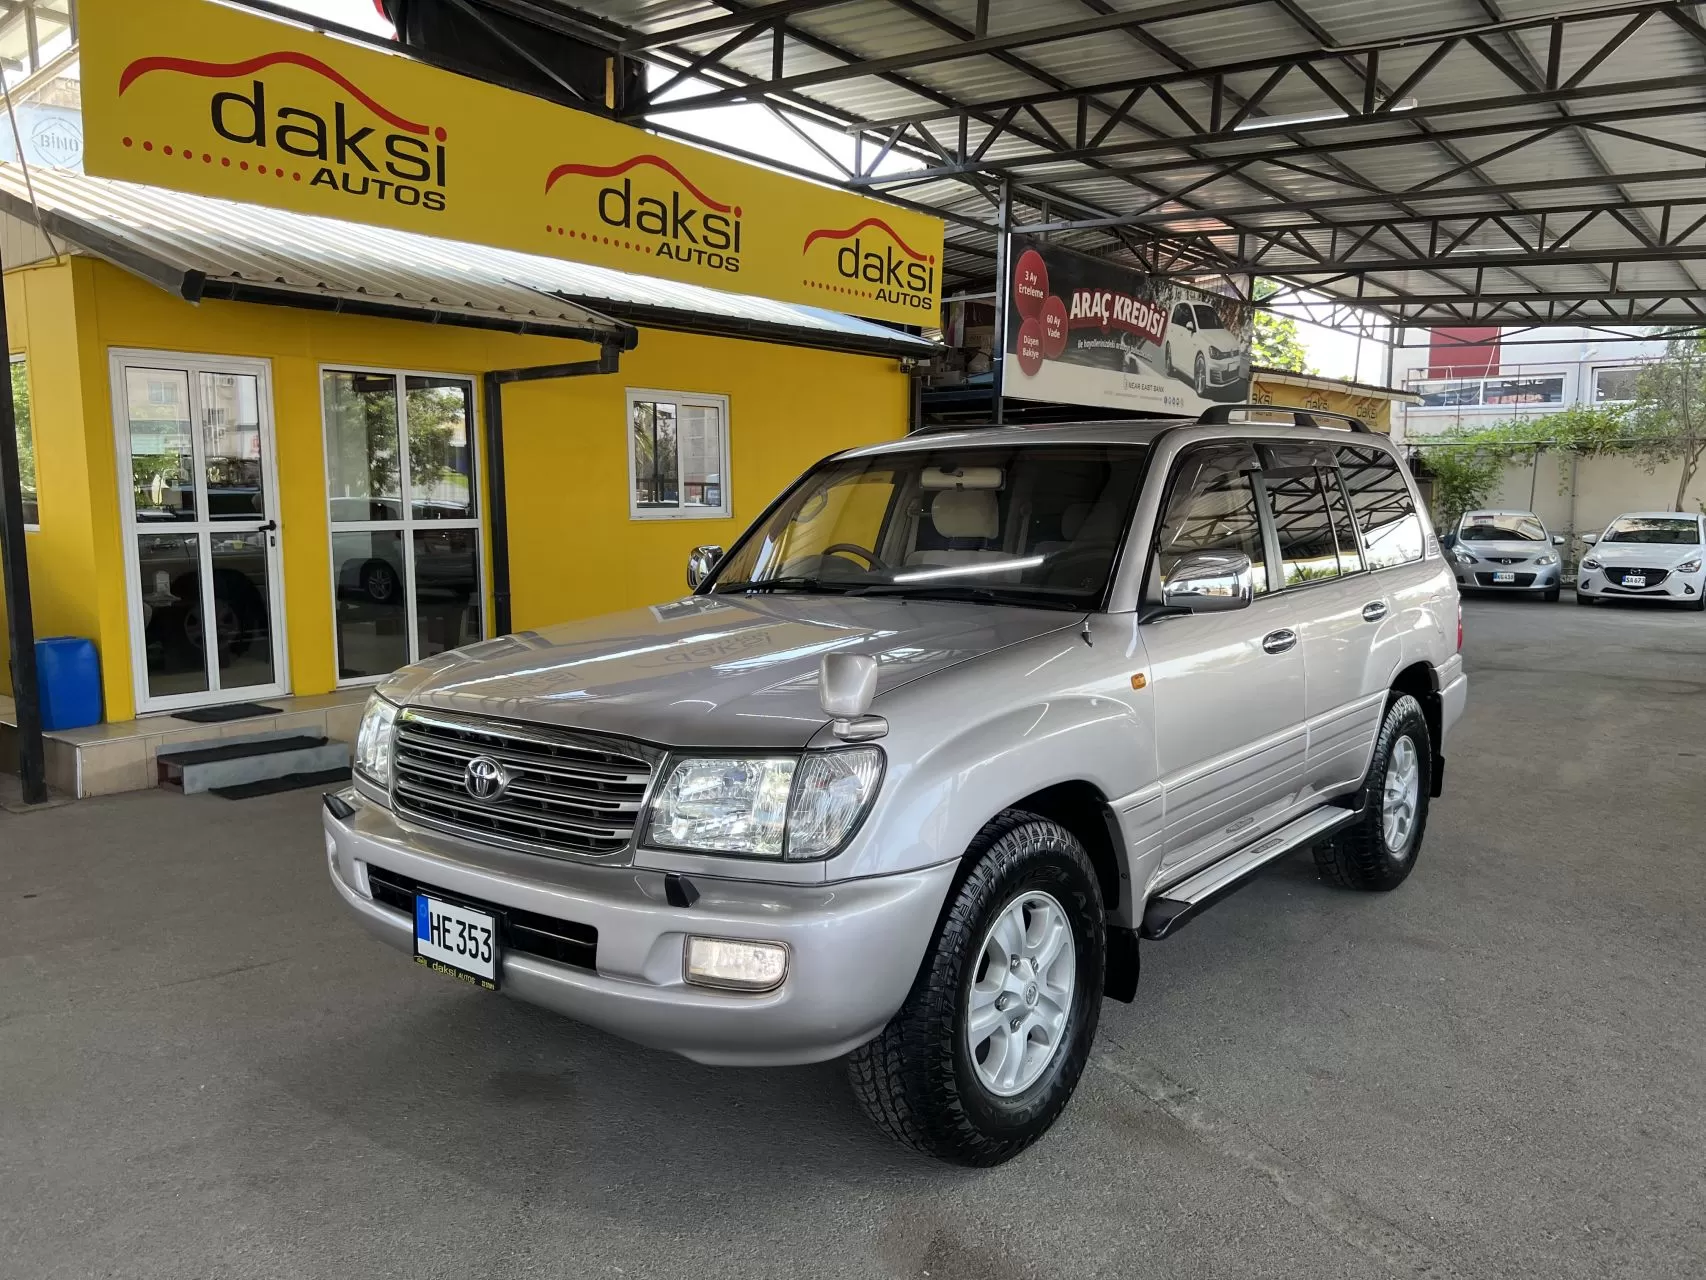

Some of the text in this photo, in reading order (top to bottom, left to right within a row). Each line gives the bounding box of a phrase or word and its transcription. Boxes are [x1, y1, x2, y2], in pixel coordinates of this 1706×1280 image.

[210, 79, 447, 188] daksi
[309, 167, 447, 212] AUTOS
[598, 178, 742, 254] daksi
[655, 241, 740, 273] AUTOS
[838, 238, 935, 294] daksi
[1025, 270, 1038, 285] 3 Ay
[875, 287, 933, 311] AUTOS
[1019, 284, 1043, 299] Erteleme
[1046, 314, 1061, 328] 60 Ay
[1069, 292, 1166, 338] ARAÇ KREDİSİ
[1023, 335, 1039, 347] Düşen
[1047, 327, 1060, 339] Vade
[1022, 347, 1039, 360] Bakiye
[1128, 382, 1165, 393] NEAR EAST BANK
[1251, 388, 1273, 406] aksi
[430, 911, 492, 964] HE 353
[432, 962, 457, 978] daksi
[458, 972, 476, 985] AUTOS
